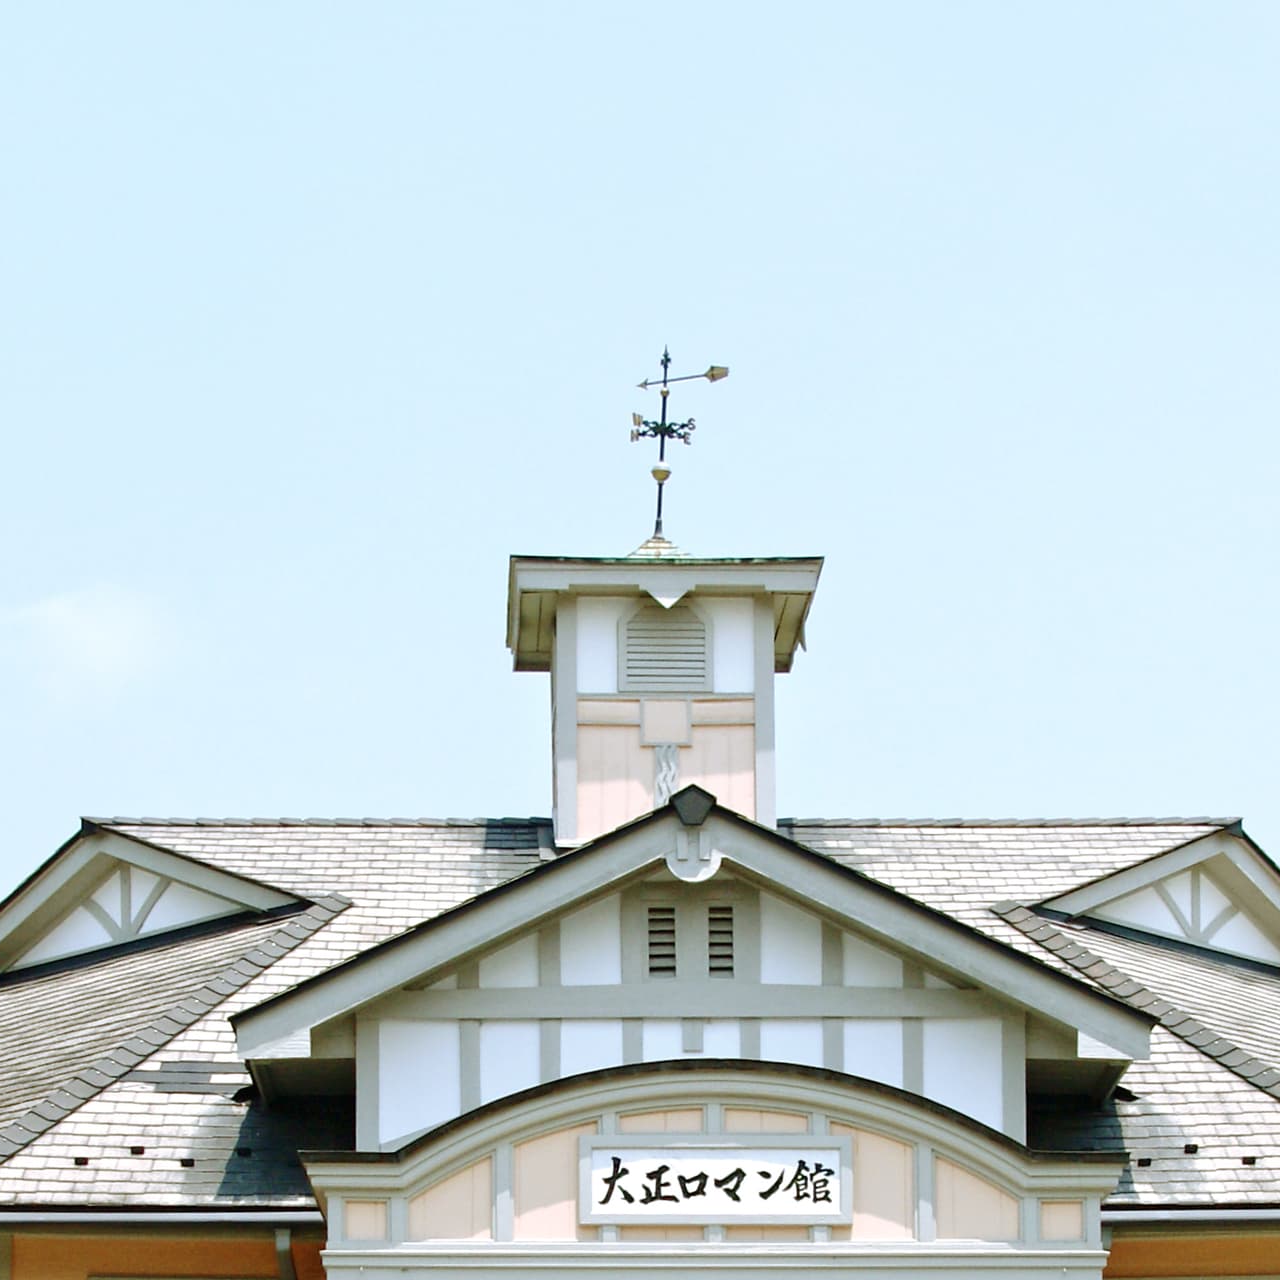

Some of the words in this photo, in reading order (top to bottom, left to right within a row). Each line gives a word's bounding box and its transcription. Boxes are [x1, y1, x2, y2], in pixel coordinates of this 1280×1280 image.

[598, 1156, 835, 1205] 大正ロマン館
